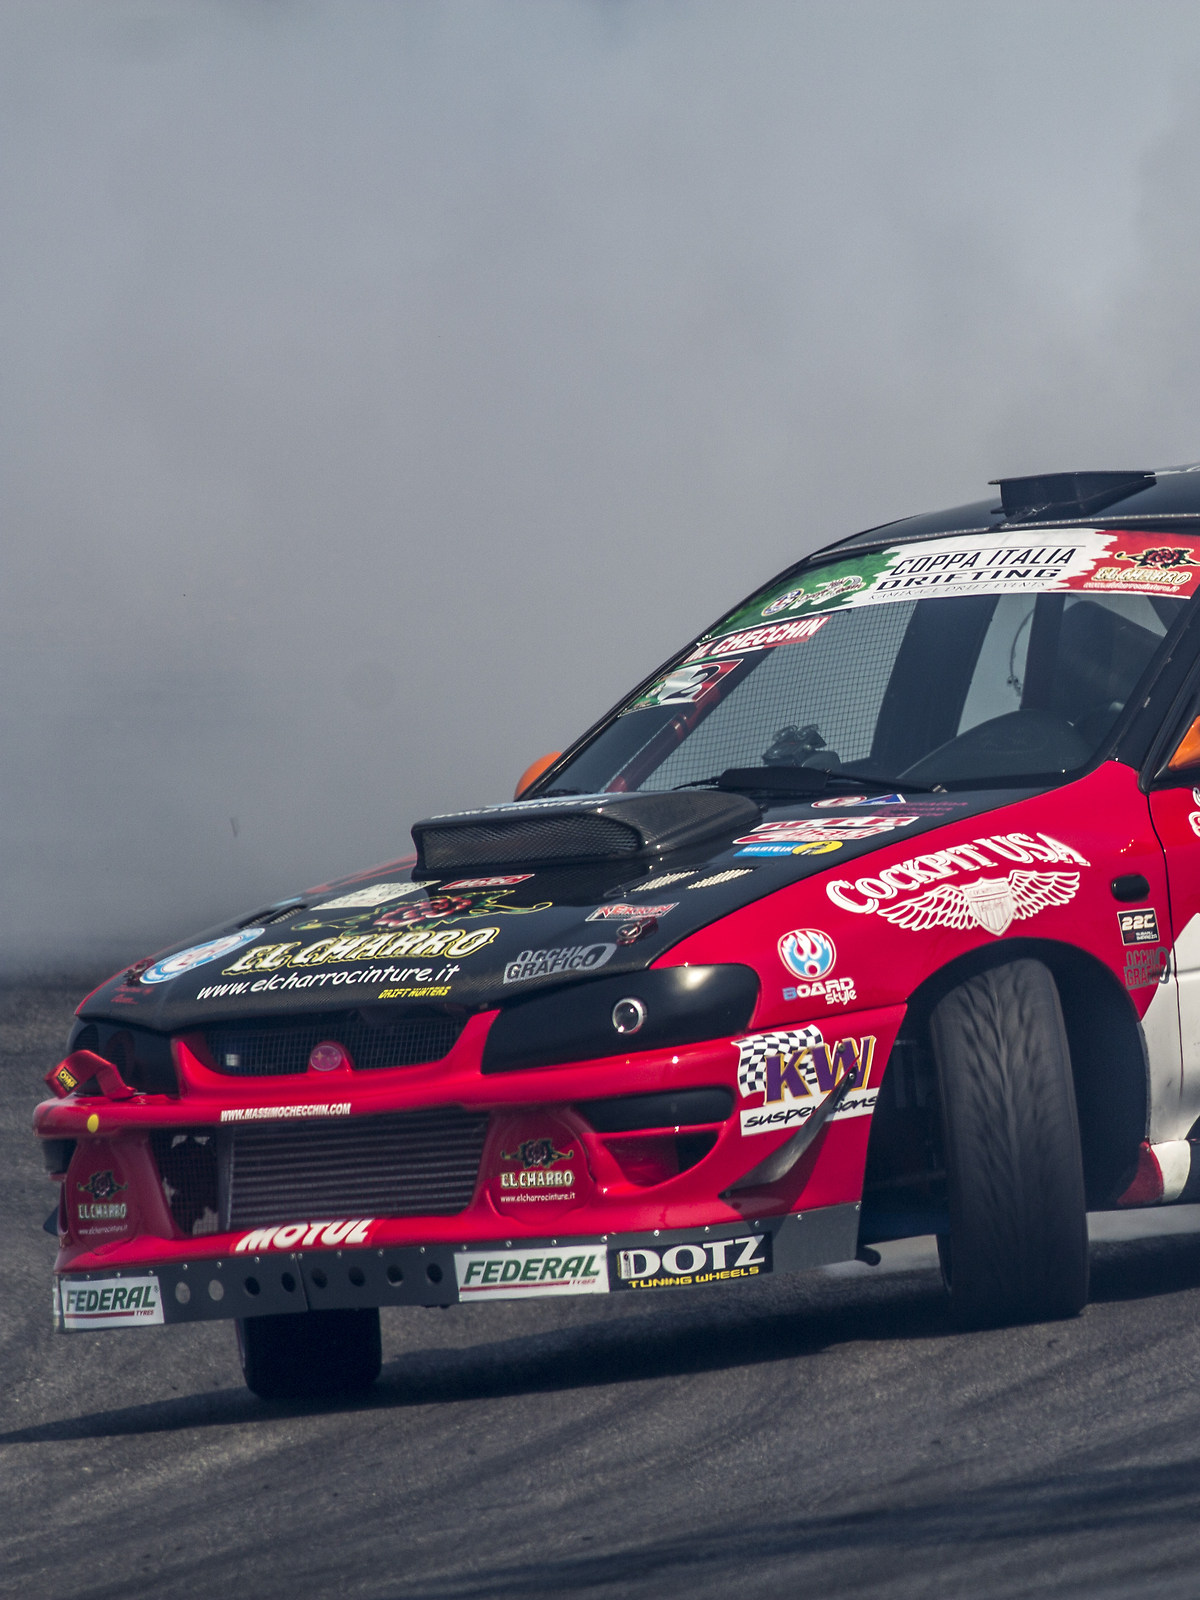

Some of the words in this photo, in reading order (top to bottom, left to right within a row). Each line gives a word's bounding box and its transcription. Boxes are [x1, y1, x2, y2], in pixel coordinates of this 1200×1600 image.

[889, 551, 982, 577] COPPA
[985, 547, 1078, 566] ITALIA
[876, 568, 1062, 591] DRIFTING
[1091, 566, 1121, 581] EL
[1117, 567, 1192, 585] CHARRO
[710, 616, 831, 655] CHECCHIN
[973, 831, 1091, 867] USA
[221, 940, 302, 976] EL
[287, 926, 500, 969] CHARRO
[196, 963, 461, 1001] www.elcharrocinture.it
[378, 987, 412, 1000] DRIFT
[782, 977, 855, 1001] BOARD
[825, 988, 857, 1006] style
[58, 1070, 77, 1088] OMP
[763, 1034, 877, 1106] KW
[220, 1102, 351, 1122] WWW.MASSIMOCHECCHIN.COM
[743, 1095, 878, 1128] suspeions
[500, 1172, 524, 1188] EL
[525, 1169, 574, 1188] CHARRO
[500, 1191, 576, 1203] www.elcharrocinture.it
[78, 1204, 90, 1219] EL
[89, 1203, 127, 1219] CHARRO
[235, 1217, 376, 1252] MOTUL
[618, 1234, 766, 1280] DOTZ
[463, 1254, 601, 1286] FEDERAL
[628, 1275, 692, 1289] TUNING
[695, 1265, 760, 1284] WHEELS
[66, 1285, 157, 1312] FEDERAL
